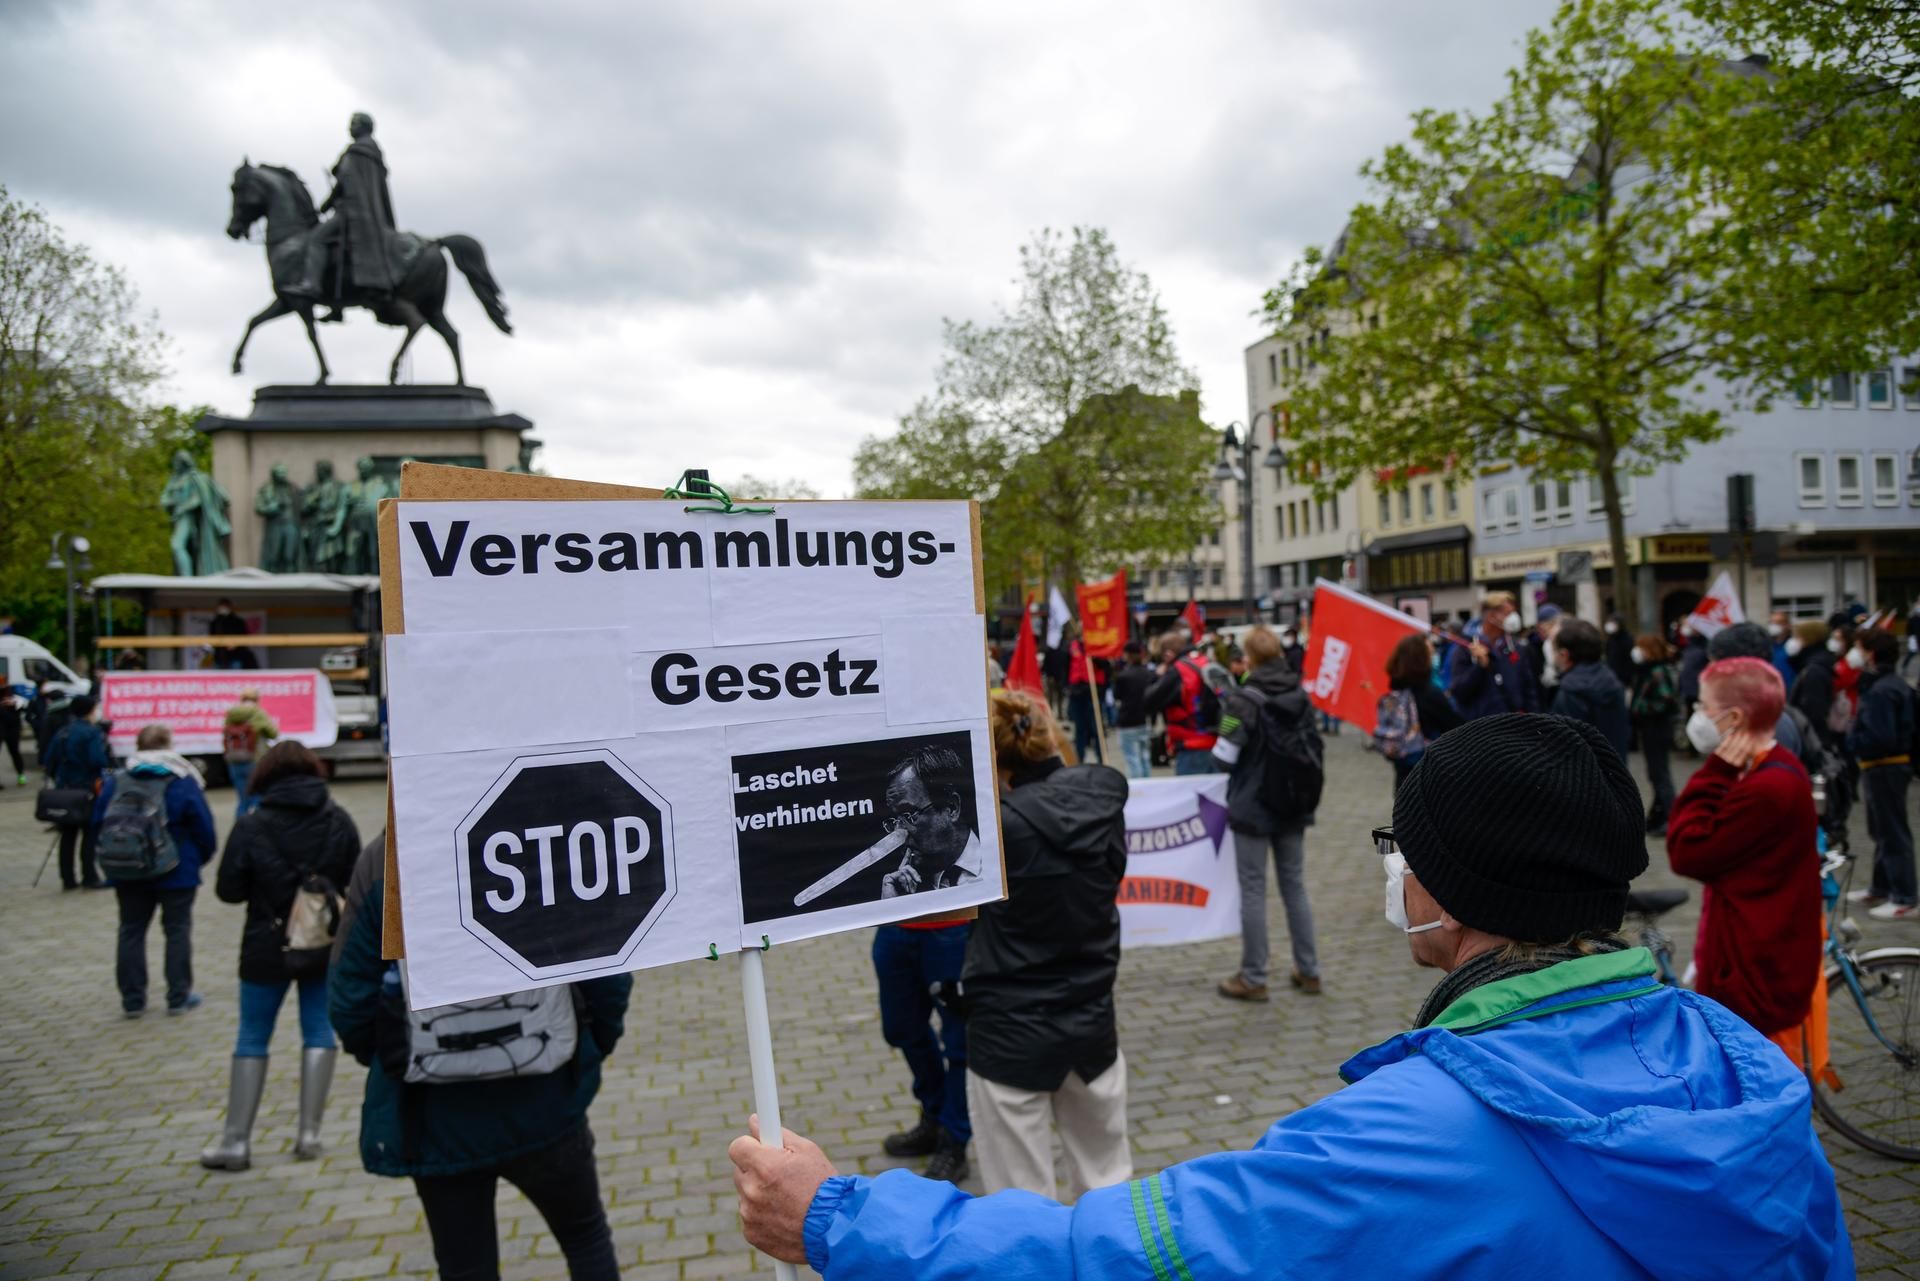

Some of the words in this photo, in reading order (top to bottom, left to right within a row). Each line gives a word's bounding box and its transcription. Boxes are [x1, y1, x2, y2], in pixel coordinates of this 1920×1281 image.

[409, 518, 956, 578] Versammlungs-
[650, 648, 880, 706] Gesetz
[732, 761, 838, 794] Laschet
[735, 795, 874, 832] verhindern
[482, 815, 651, 914] STOP
